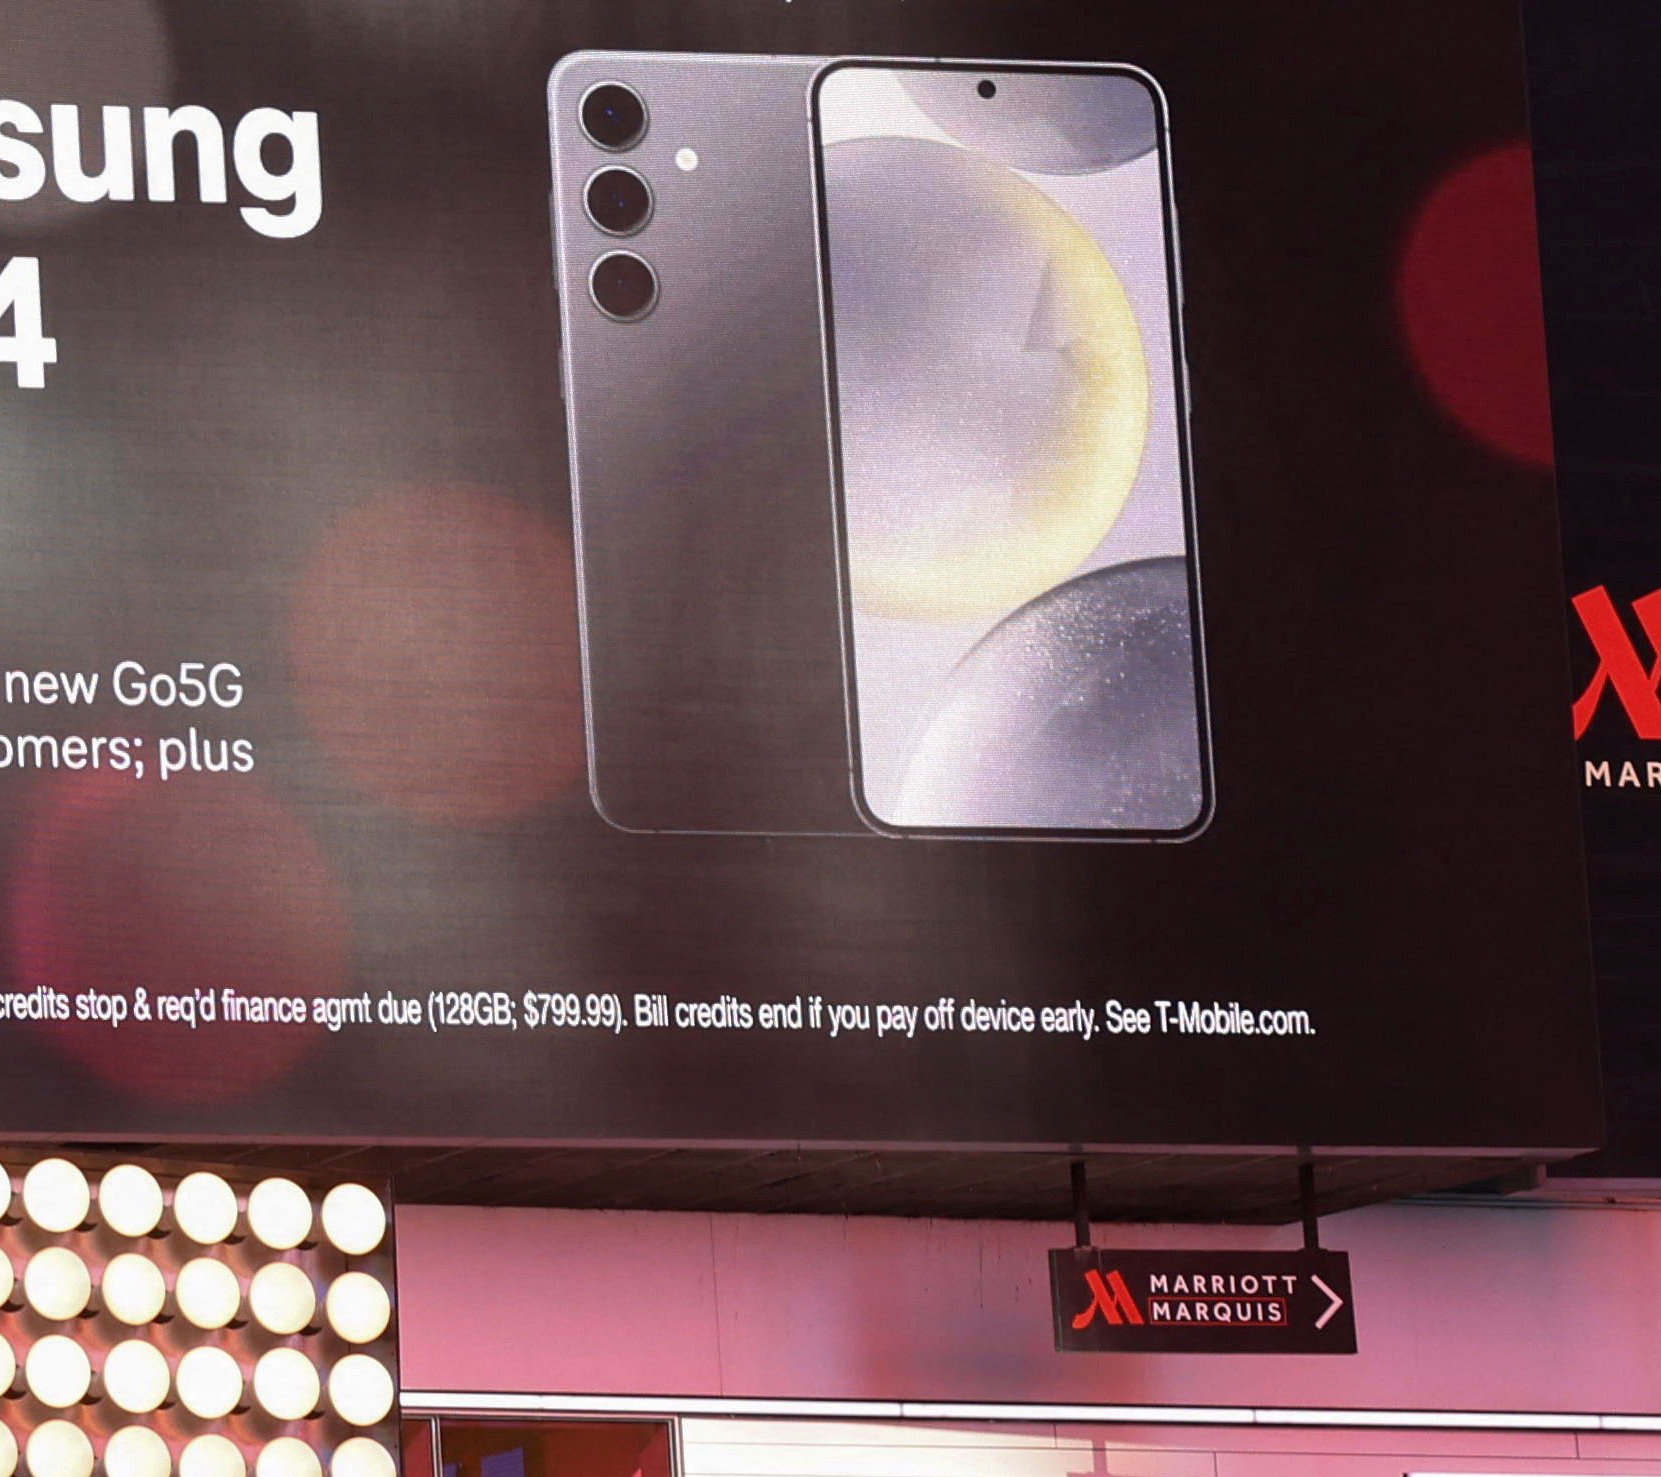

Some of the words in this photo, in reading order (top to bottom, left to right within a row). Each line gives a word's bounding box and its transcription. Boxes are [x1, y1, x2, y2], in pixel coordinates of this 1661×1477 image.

[4, 670, 99, 706] new
[112, 660, 245, 709] Go5G
[158, 726, 255, 780] plus
[1584, 760, 1661, 789] MAR
[75, 990, 128, 1028] stop
[133, 989, 153, 1021] &
[157, 988, 216, 1029] req'd
[221, 988, 307, 1023] finance
[312, 989, 371, 1032] agmt
[378, 990, 422, 1024] due
[428, 990, 519, 1032] (128GB;
[523, 990, 628, 1034] $799.99).
[634, 993, 669, 1028] Bill
[674, 993, 754, 1030] credits
[759, 993, 802, 1030] end
[807, 995, 824, 1030] if
[827, 1002, 871, 1037] you
[875, 1002, 918, 1038] pay
[923, 997, 956, 1031] off
[960, 997, 1036, 1032] device
[1040, 998, 1100, 1041] early.
[1105, 999, 1151, 1034] See
[1158, 1000, 1317, 1036] T-Mobile.com.
[1149, 1274, 1298, 1295] MARRIOTT
[1152, 1301, 1283, 1323] MARQUIS
